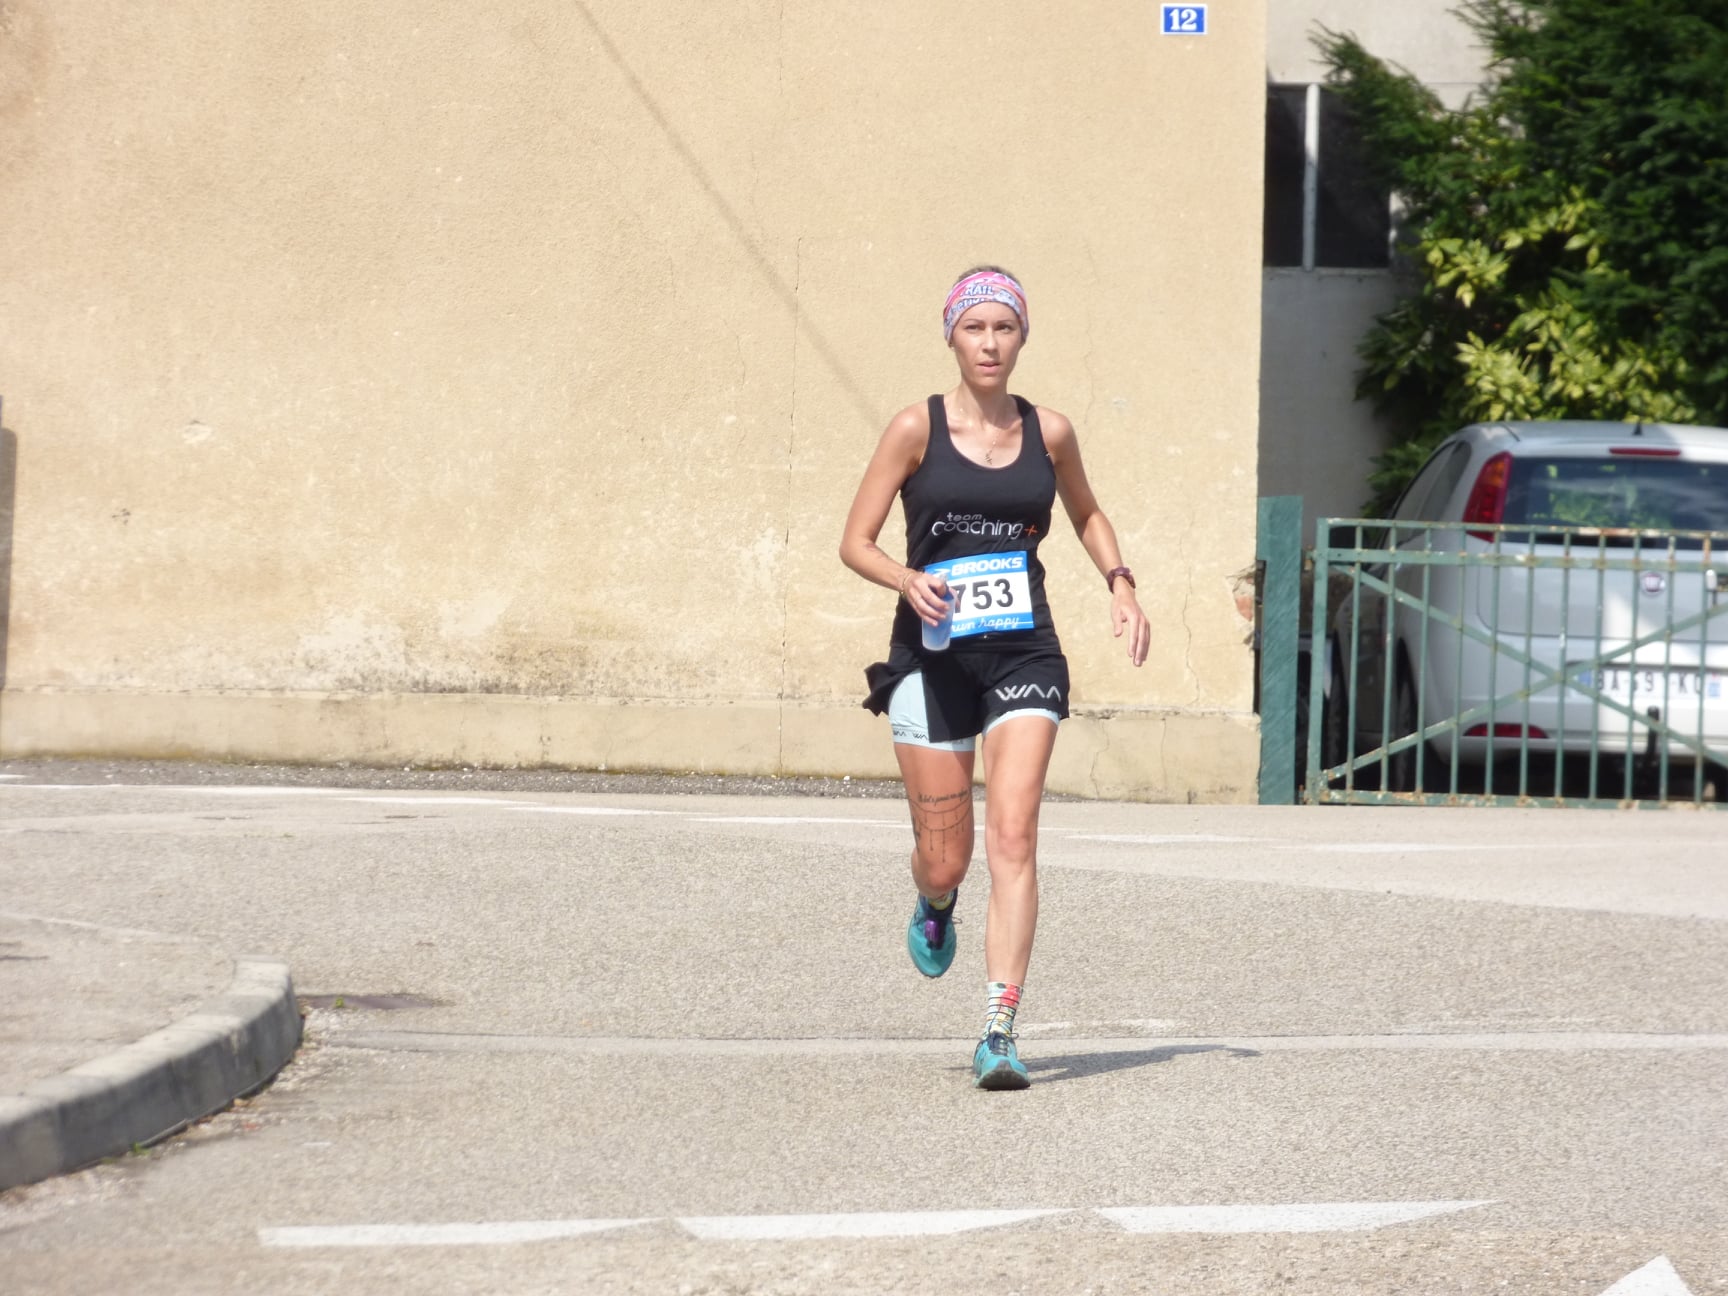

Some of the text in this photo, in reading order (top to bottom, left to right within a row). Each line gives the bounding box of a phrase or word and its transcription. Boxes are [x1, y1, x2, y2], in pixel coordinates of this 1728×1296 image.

[1169, 8, 1198, 31] 12
[946, 511, 983, 522] team
[951, 556, 1024, 577] BROOKS
[950, 578, 1014, 614] 753
[978, 615, 1021, 630] happy
